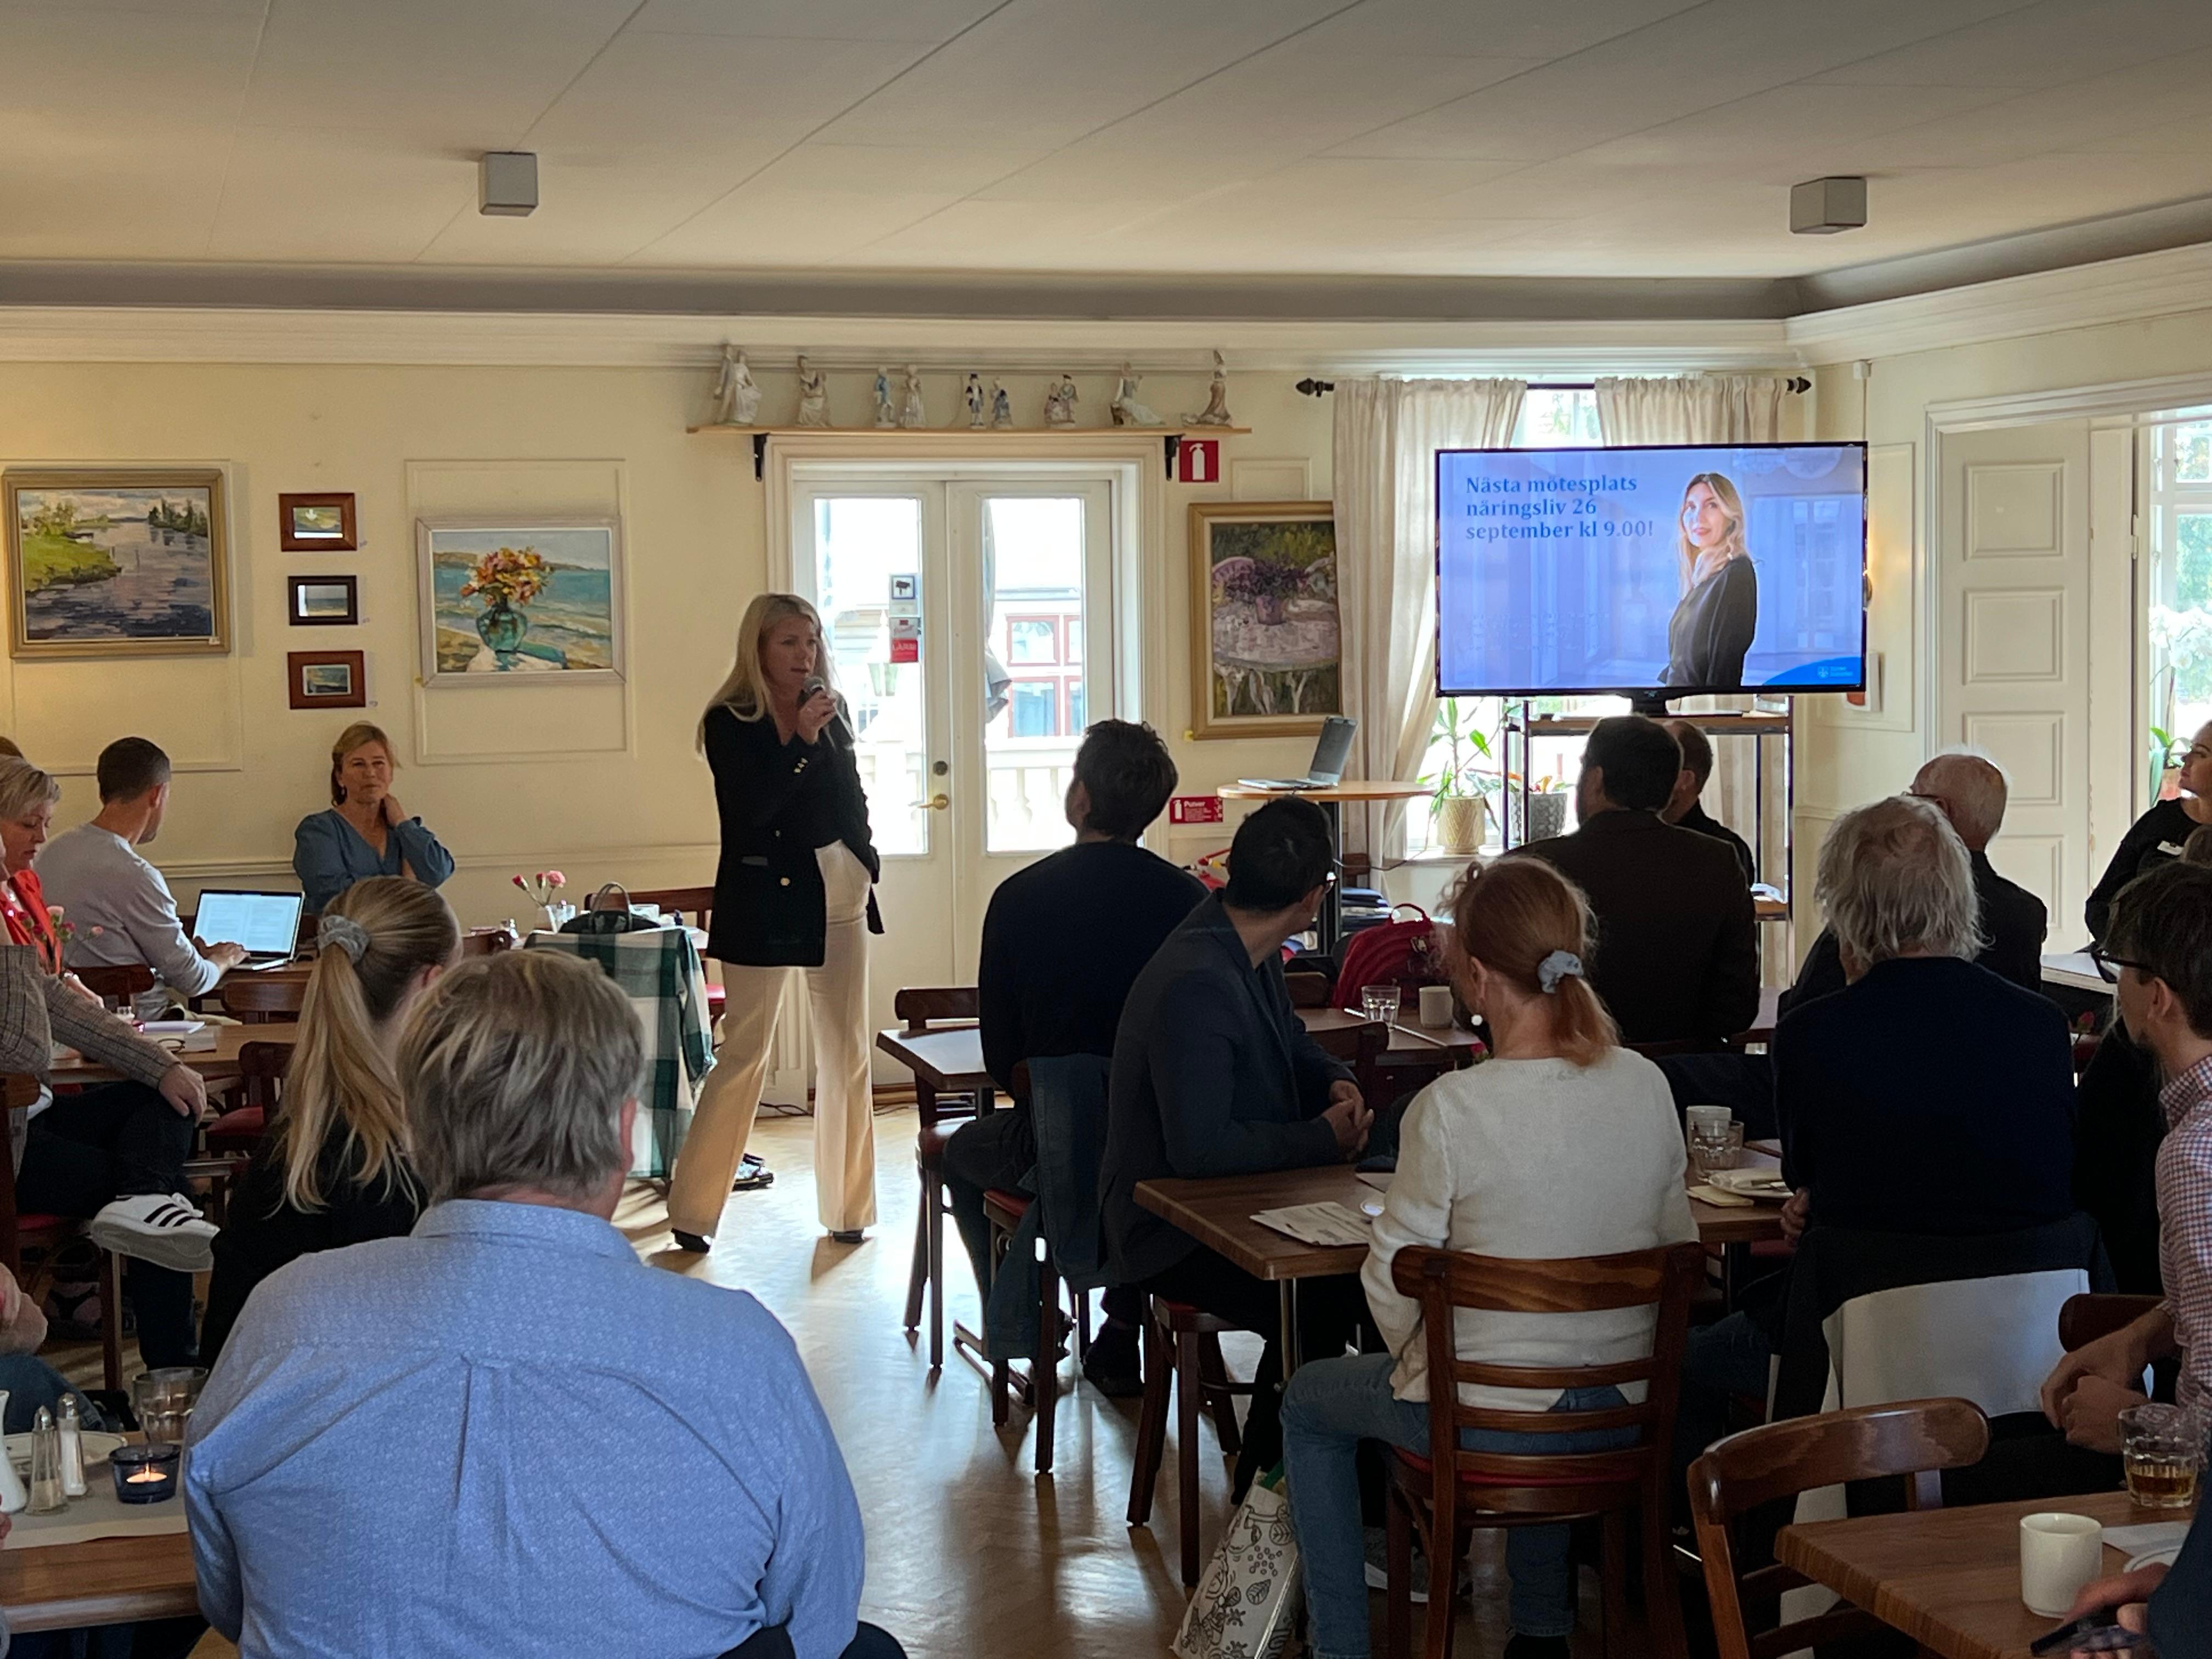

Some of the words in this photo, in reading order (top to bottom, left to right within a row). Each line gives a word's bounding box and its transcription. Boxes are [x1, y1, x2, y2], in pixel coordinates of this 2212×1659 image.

[1466, 477, 1521, 493] Nästa
[1528, 475, 1637, 495] mötesplats
[1466, 499, 1566, 519] näringsliv
[1572, 498, 1596, 514] 26
[1466, 522, 1573, 543] september
[1579, 521, 1597, 537] kl
[1604, 521, 1654, 537] 9.00!
